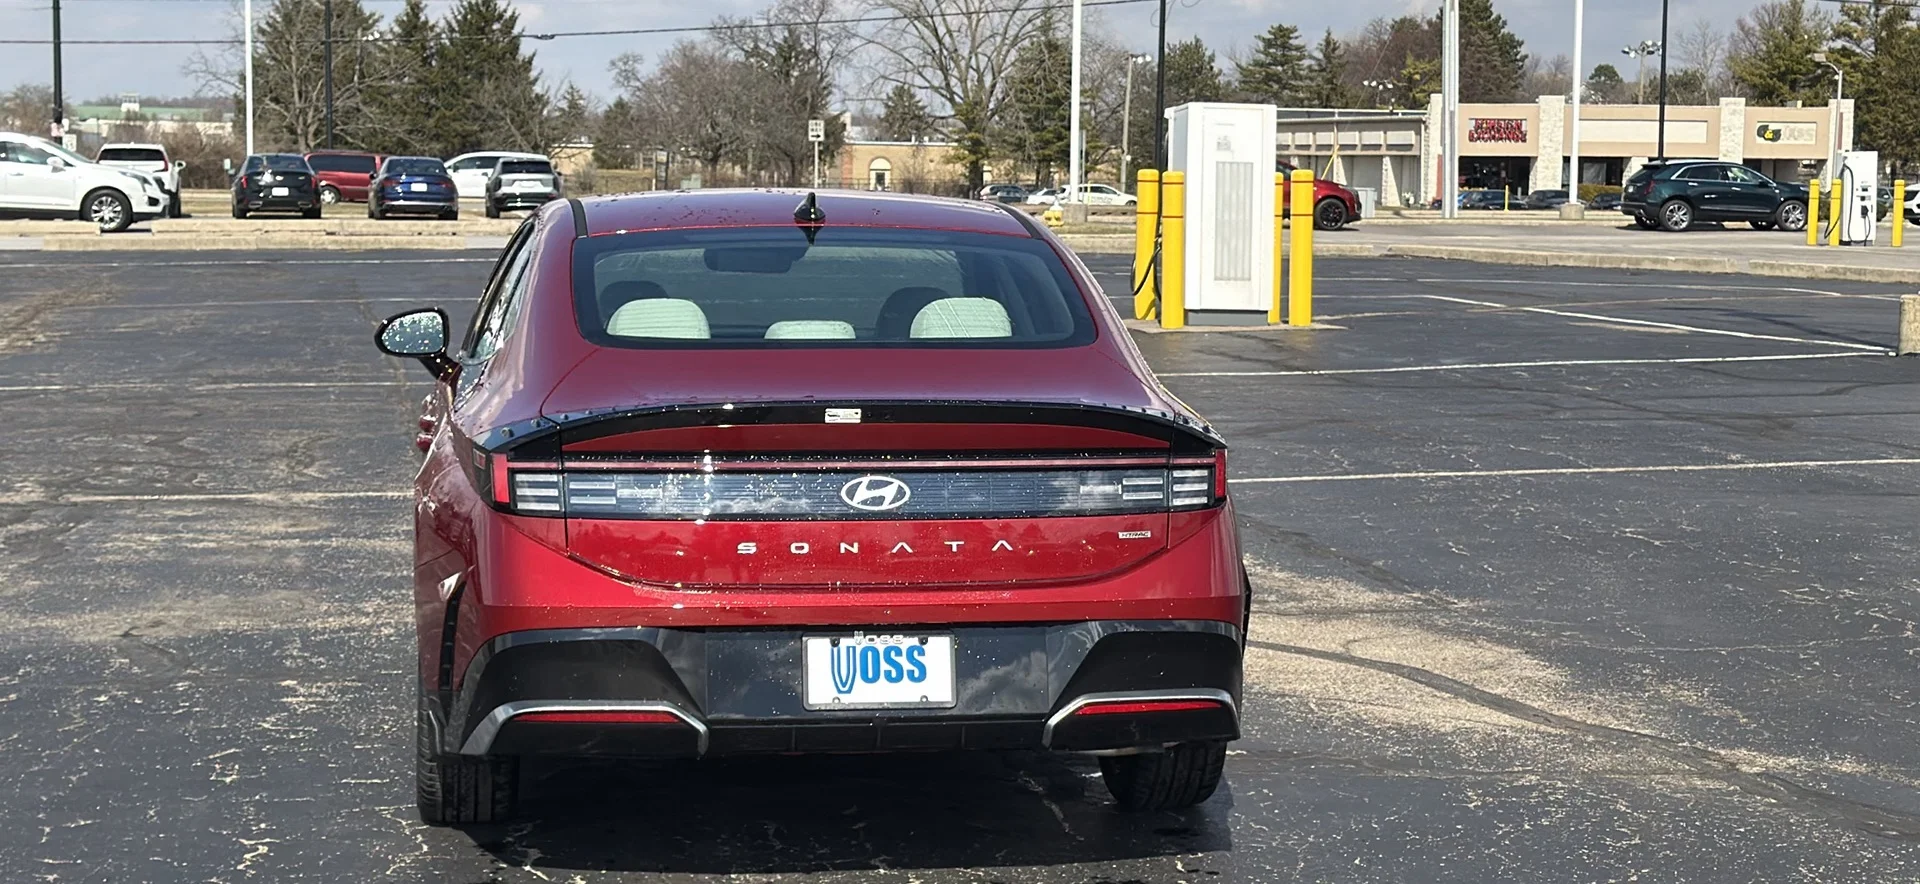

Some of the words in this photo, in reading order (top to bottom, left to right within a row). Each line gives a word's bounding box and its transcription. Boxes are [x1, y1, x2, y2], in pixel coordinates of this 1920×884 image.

[1468, 130, 1527, 142] EXCHANGE
[737, 540, 1013, 554] SONATA
[831, 645, 927, 694] VOSS
